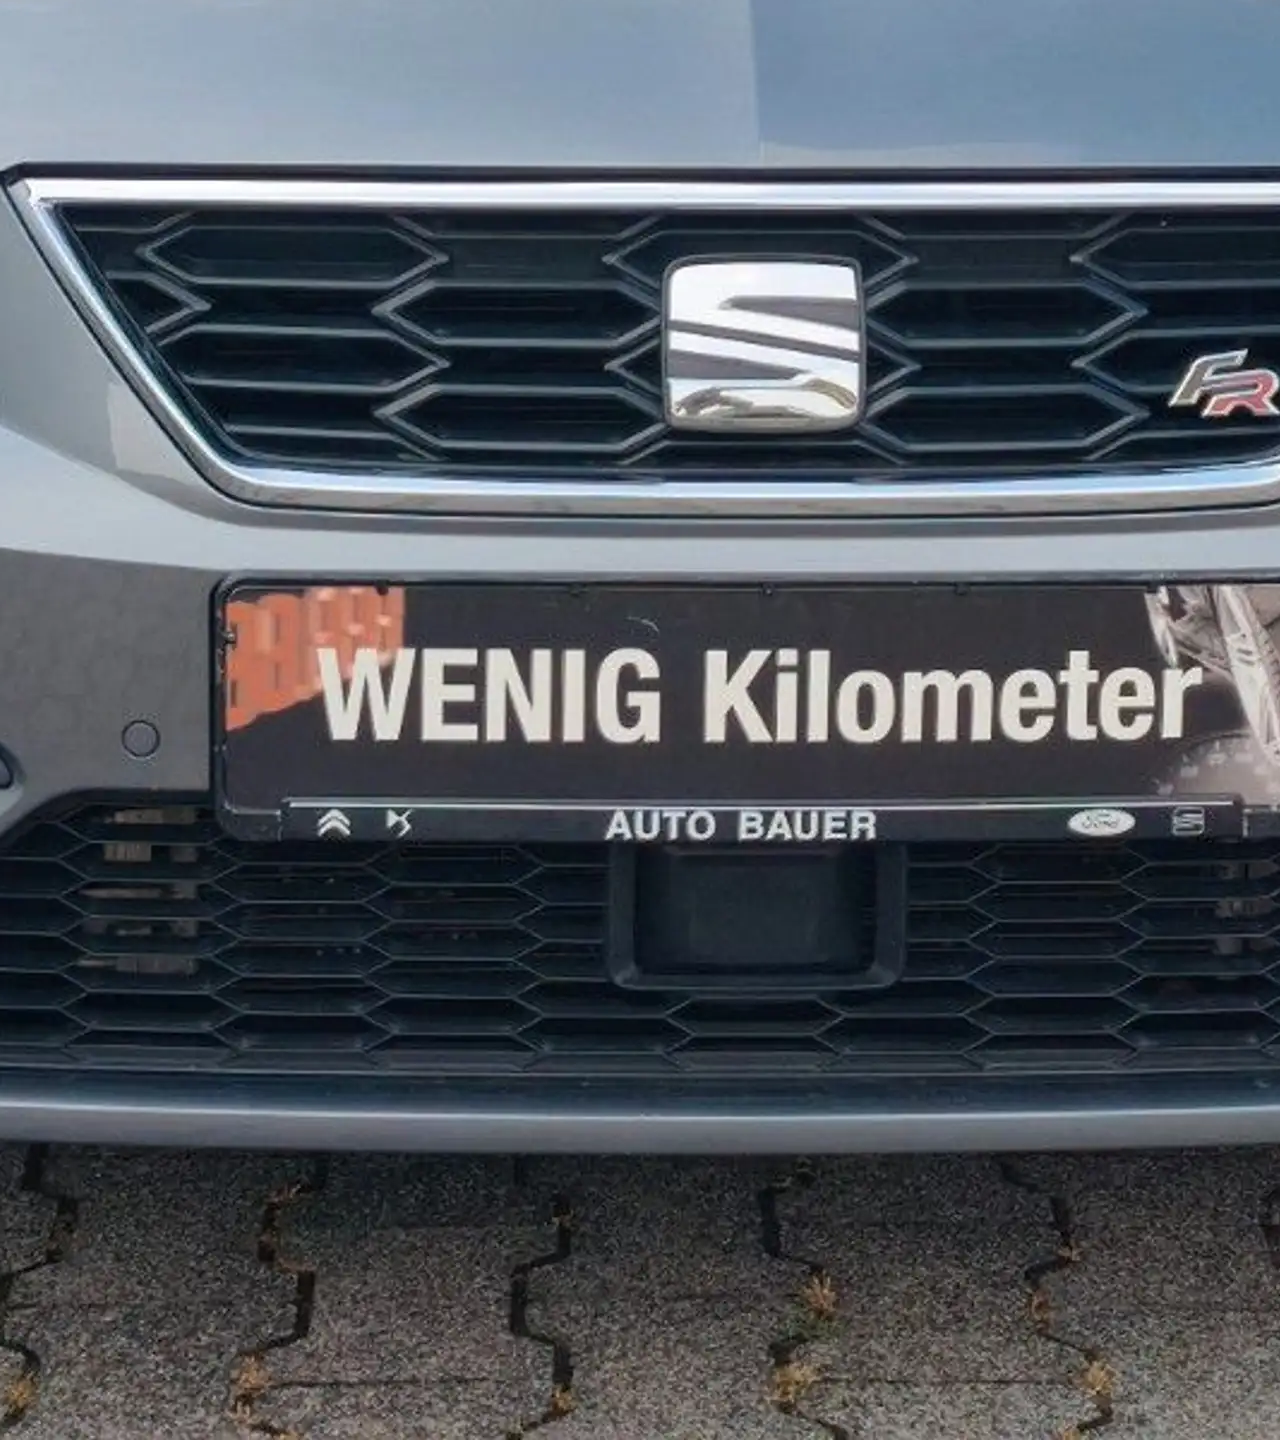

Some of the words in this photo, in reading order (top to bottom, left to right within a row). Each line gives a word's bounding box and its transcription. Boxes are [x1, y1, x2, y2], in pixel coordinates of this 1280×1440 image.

[317, 647, 661, 744] WENIG
[703, 648, 1203, 743] Kilometer
[605, 809, 717, 841] AUTO
[738, 809, 877, 841] BAUER
